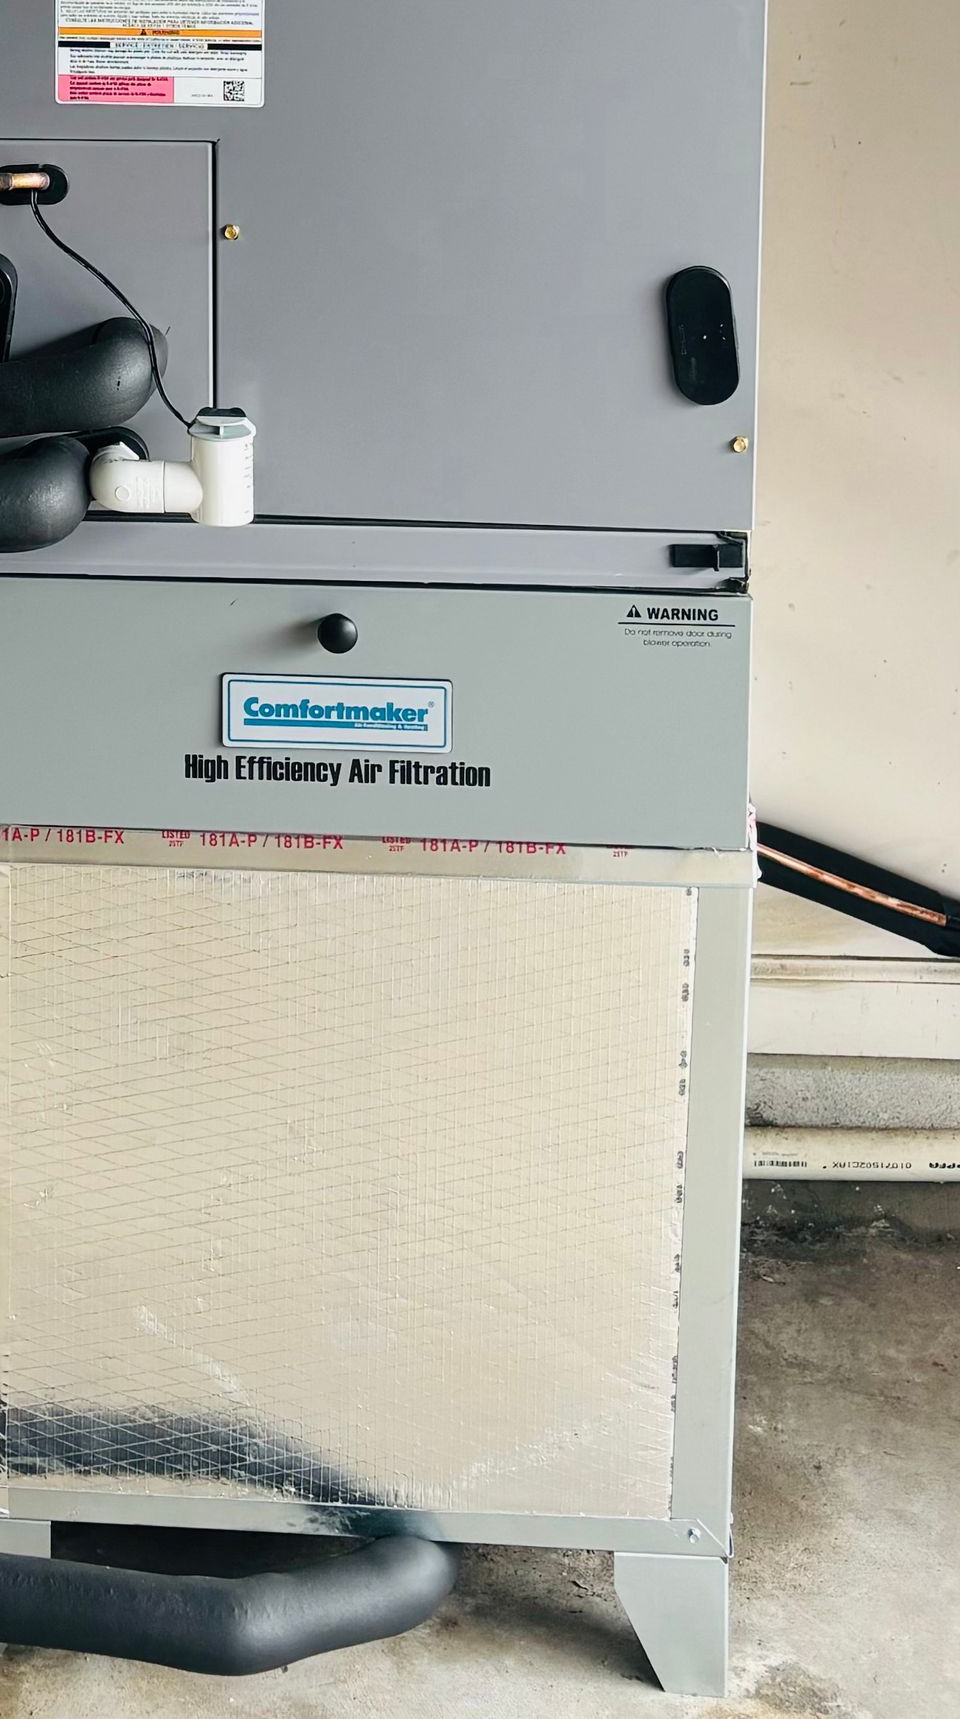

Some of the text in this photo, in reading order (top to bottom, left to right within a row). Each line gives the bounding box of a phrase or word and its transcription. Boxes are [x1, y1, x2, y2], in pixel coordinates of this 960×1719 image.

[647, 607, 718, 621] WARNING
[707, 631, 732, 639] during
[672, 640, 710, 648] operation
[244, 696, 428, 722] Comfortmaker
[185, 754, 490, 787] High Efficiency Air Filtration
[57, 829, 124, 845] 181B-FX
[199, 832, 343, 850] 181A-P 181B-FX
